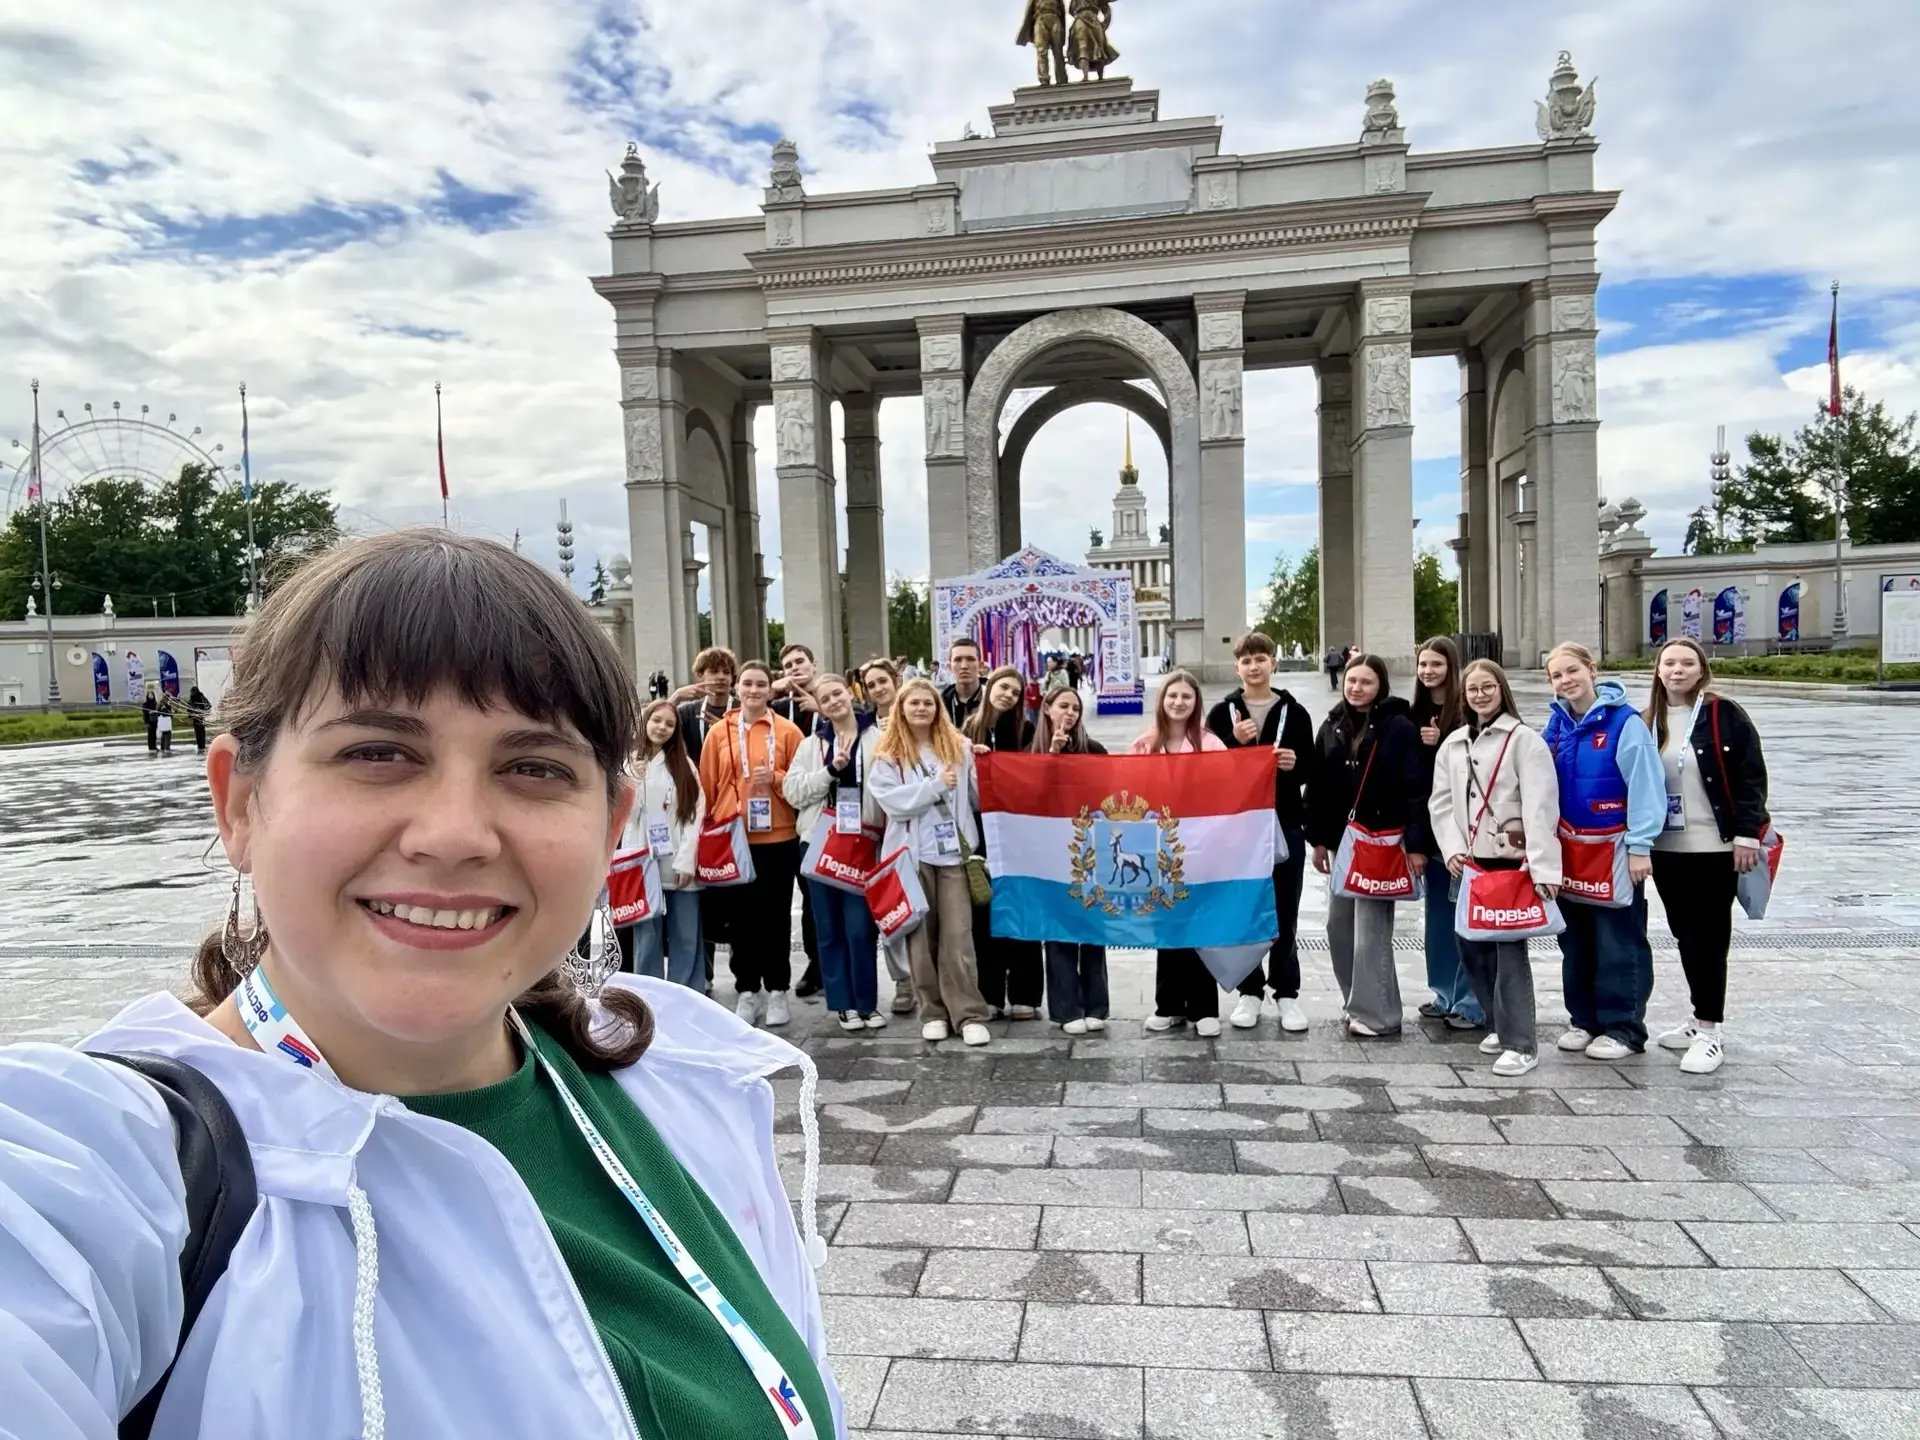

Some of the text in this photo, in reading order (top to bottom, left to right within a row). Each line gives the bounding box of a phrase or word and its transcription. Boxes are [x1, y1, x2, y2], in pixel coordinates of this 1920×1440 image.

[820, 854, 867, 880] Первы
[1350, 872, 1409, 894] Первые
[1562, 877, 1610, 893] рвые
[611, 899, 645, 921] рвые
[1473, 906, 1542, 926] Первые
[585, 1126, 682, 1254] ДВИЖЕНИЯ ПЕРВЫХ
